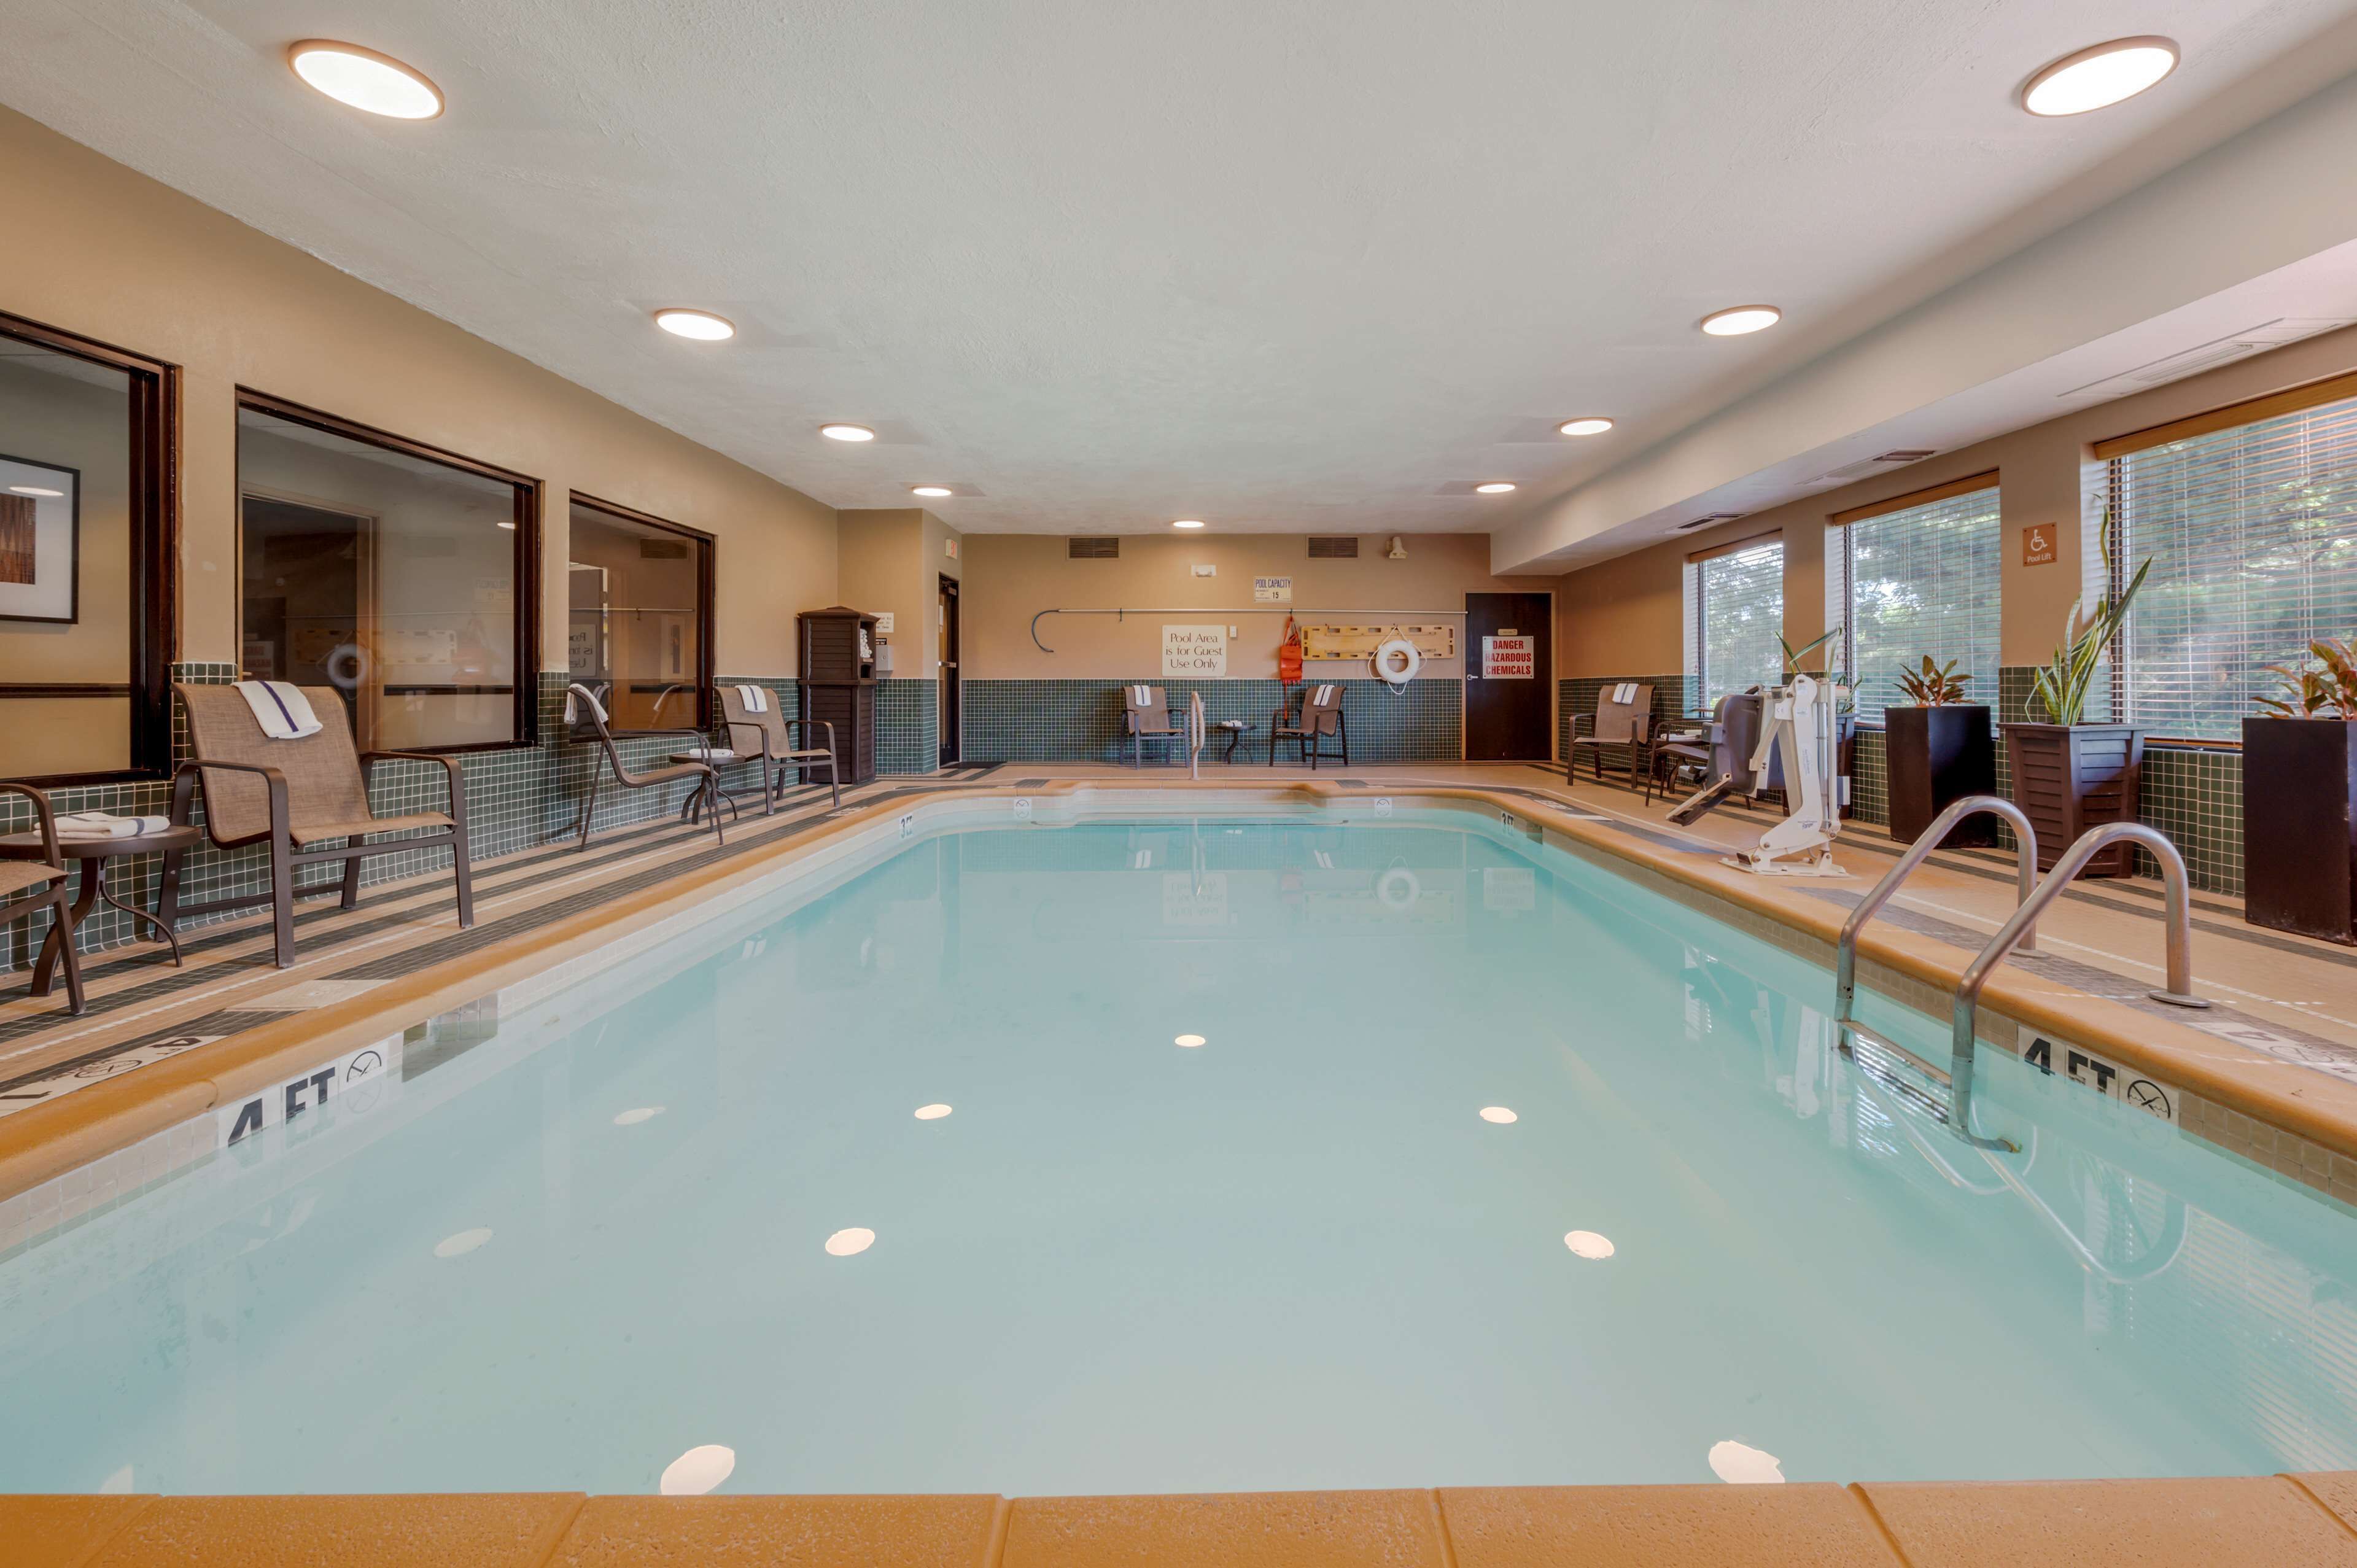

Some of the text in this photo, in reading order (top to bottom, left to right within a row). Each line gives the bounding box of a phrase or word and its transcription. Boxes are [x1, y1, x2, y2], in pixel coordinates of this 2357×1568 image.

[1256, 579, 1291, 588] POOL CAPACITY
[1170, 632, 1218, 643] Pool Area
[1166, 645, 1222, 656] is for Guest
[1486, 653, 1531, 662] HAZARDOUS
[1170, 658, 1217, 672] Use Only
[1486, 666, 1530, 674] CHEMICALS
[2024, 1038, 2116, 1095] 4 FT
[228, 1066, 335, 1148] 4 FT
